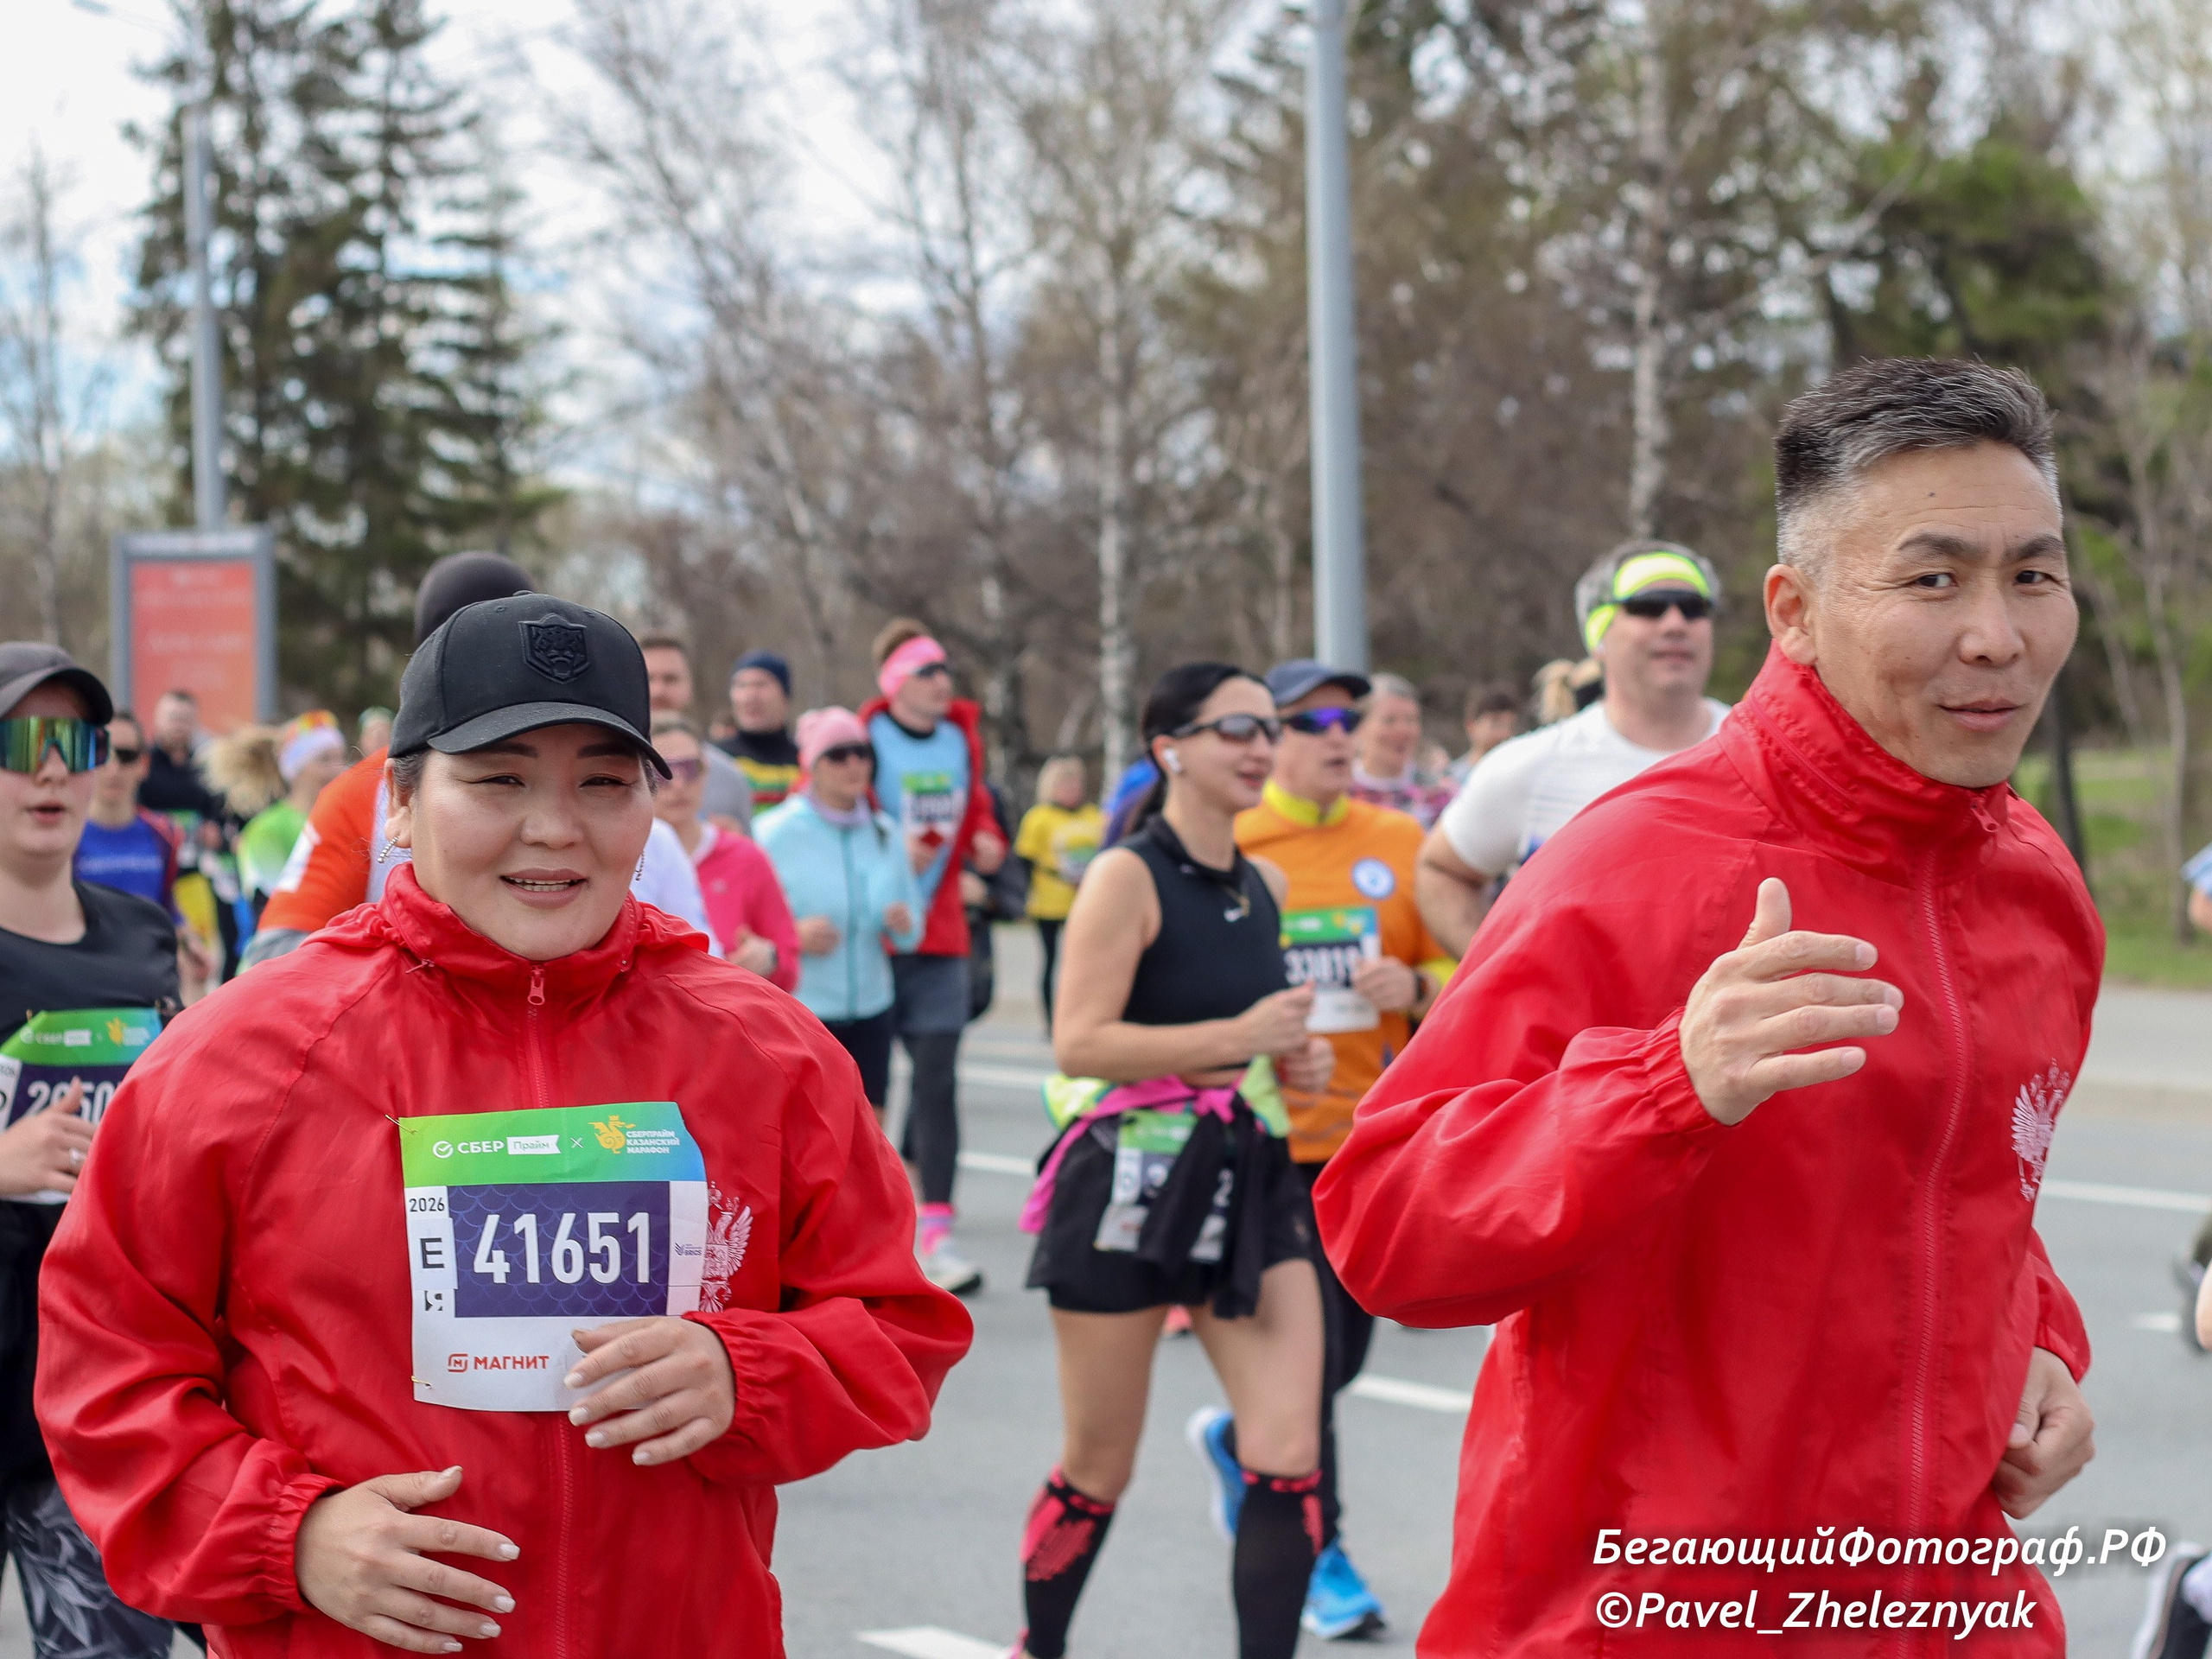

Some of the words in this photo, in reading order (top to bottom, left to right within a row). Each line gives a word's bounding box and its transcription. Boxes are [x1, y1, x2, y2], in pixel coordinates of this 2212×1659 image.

[28, 1080, 122, 1126] 250
[626, 1129, 675, 1138] СБЕРПРАЙМ
[457, 1140, 505, 1154] СБЕР
[513, 1140, 550, 1151] Прайм
[626, 1137, 680, 1146] КАЗАНСКИЙ
[409, 1197, 445, 1212] 2026
[473, 1211, 650, 1285] 41651
[474, 1355, 550, 1370] МАГНИТ
